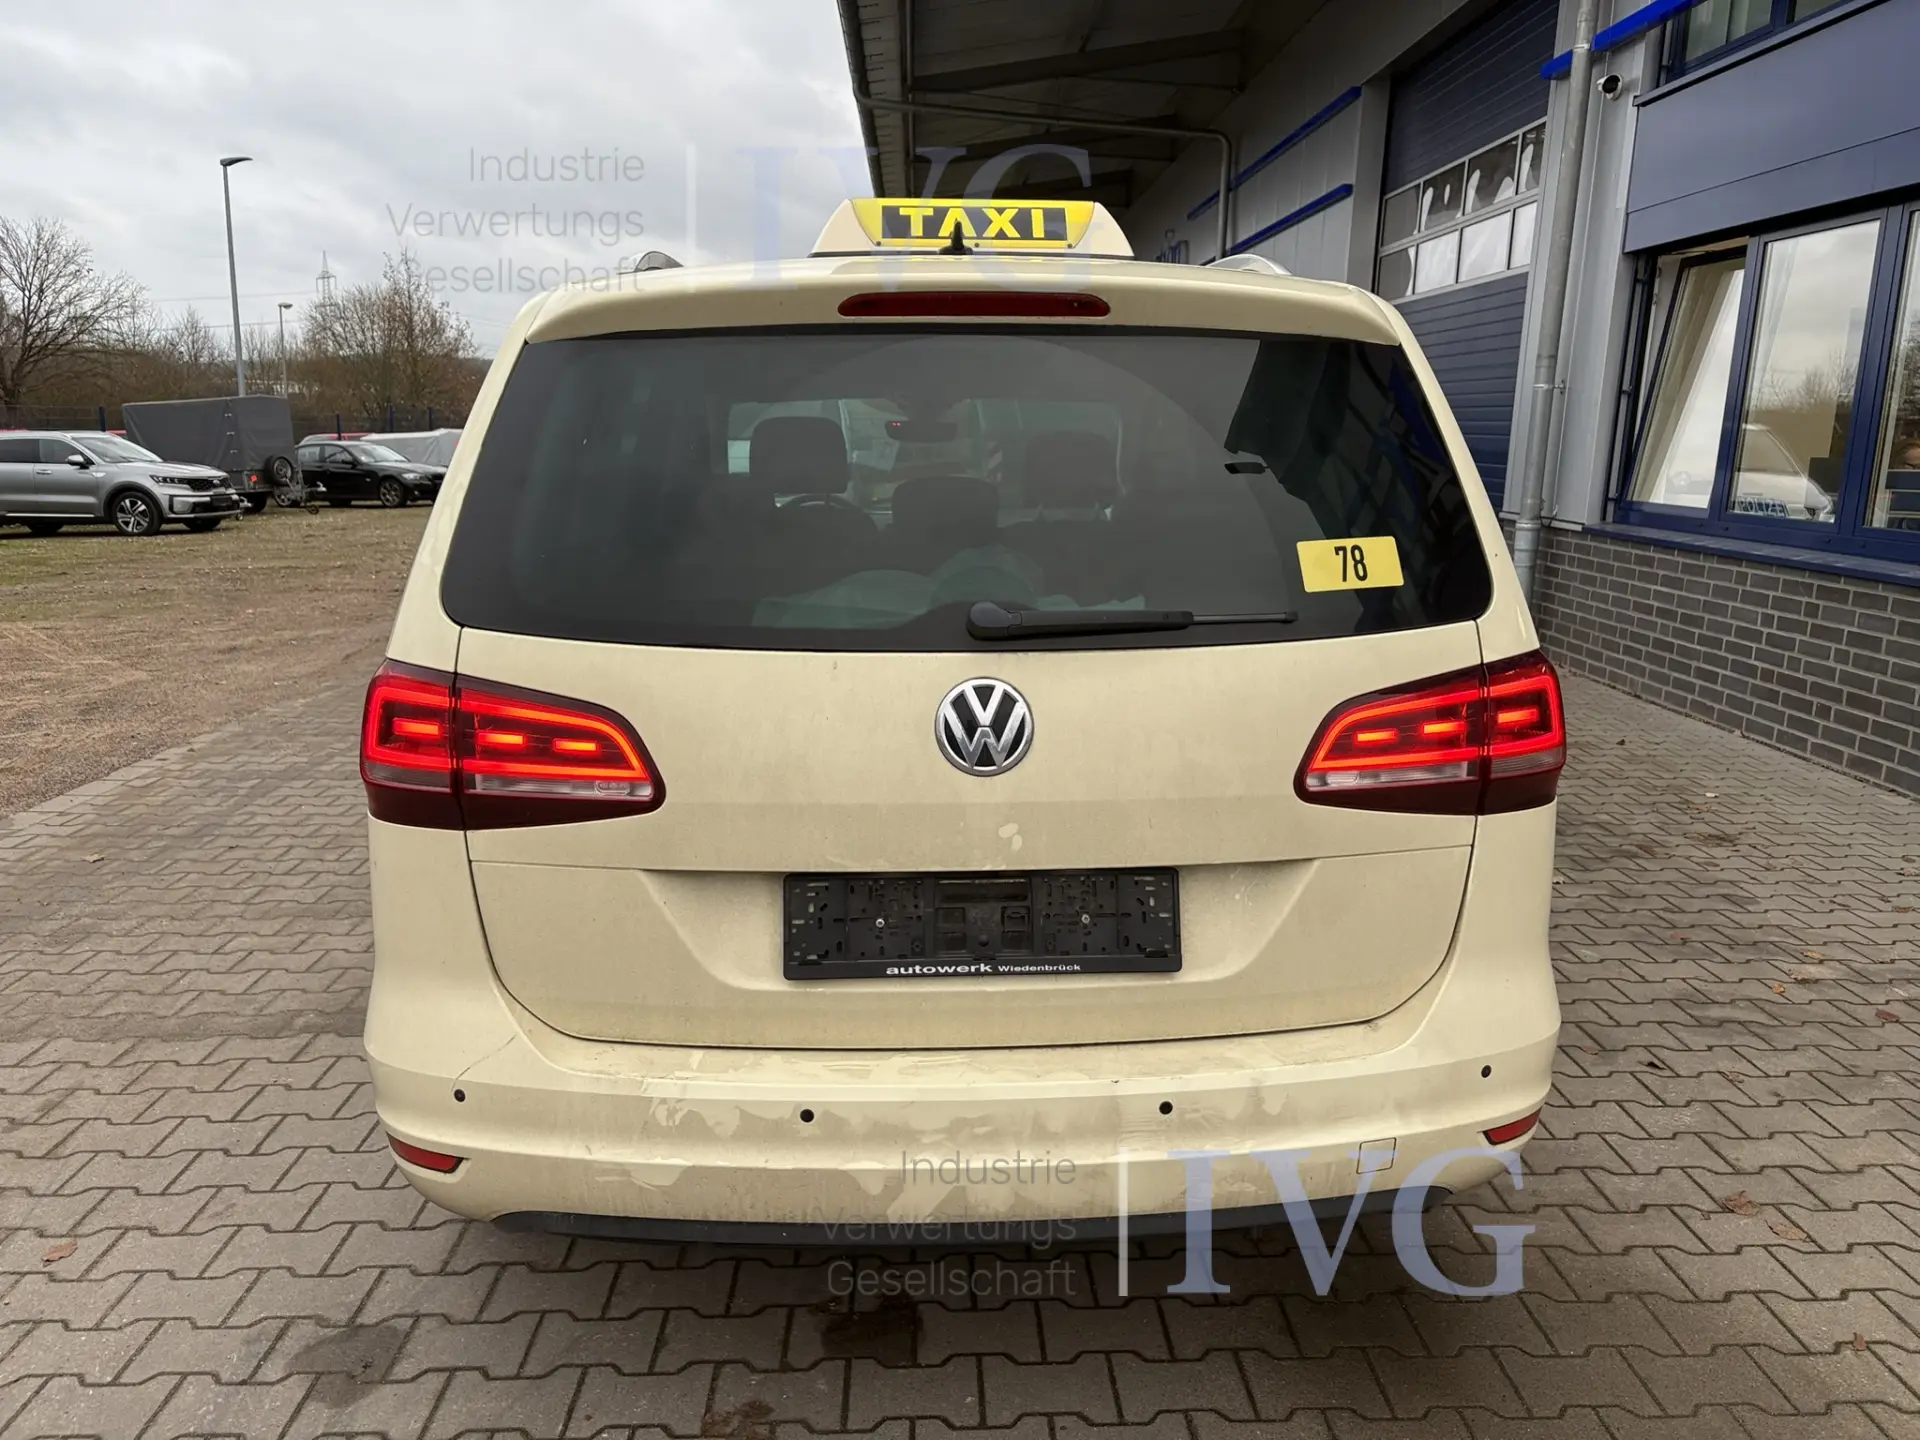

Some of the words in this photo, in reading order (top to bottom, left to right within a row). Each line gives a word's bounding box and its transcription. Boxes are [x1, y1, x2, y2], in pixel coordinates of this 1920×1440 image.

[900, 206, 1045, 238] TAXI
[1334, 545, 1368, 582] 78
[886, 963, 993, 975] autowerk
[998, 964, 1081, 972] Wiedenbrück
